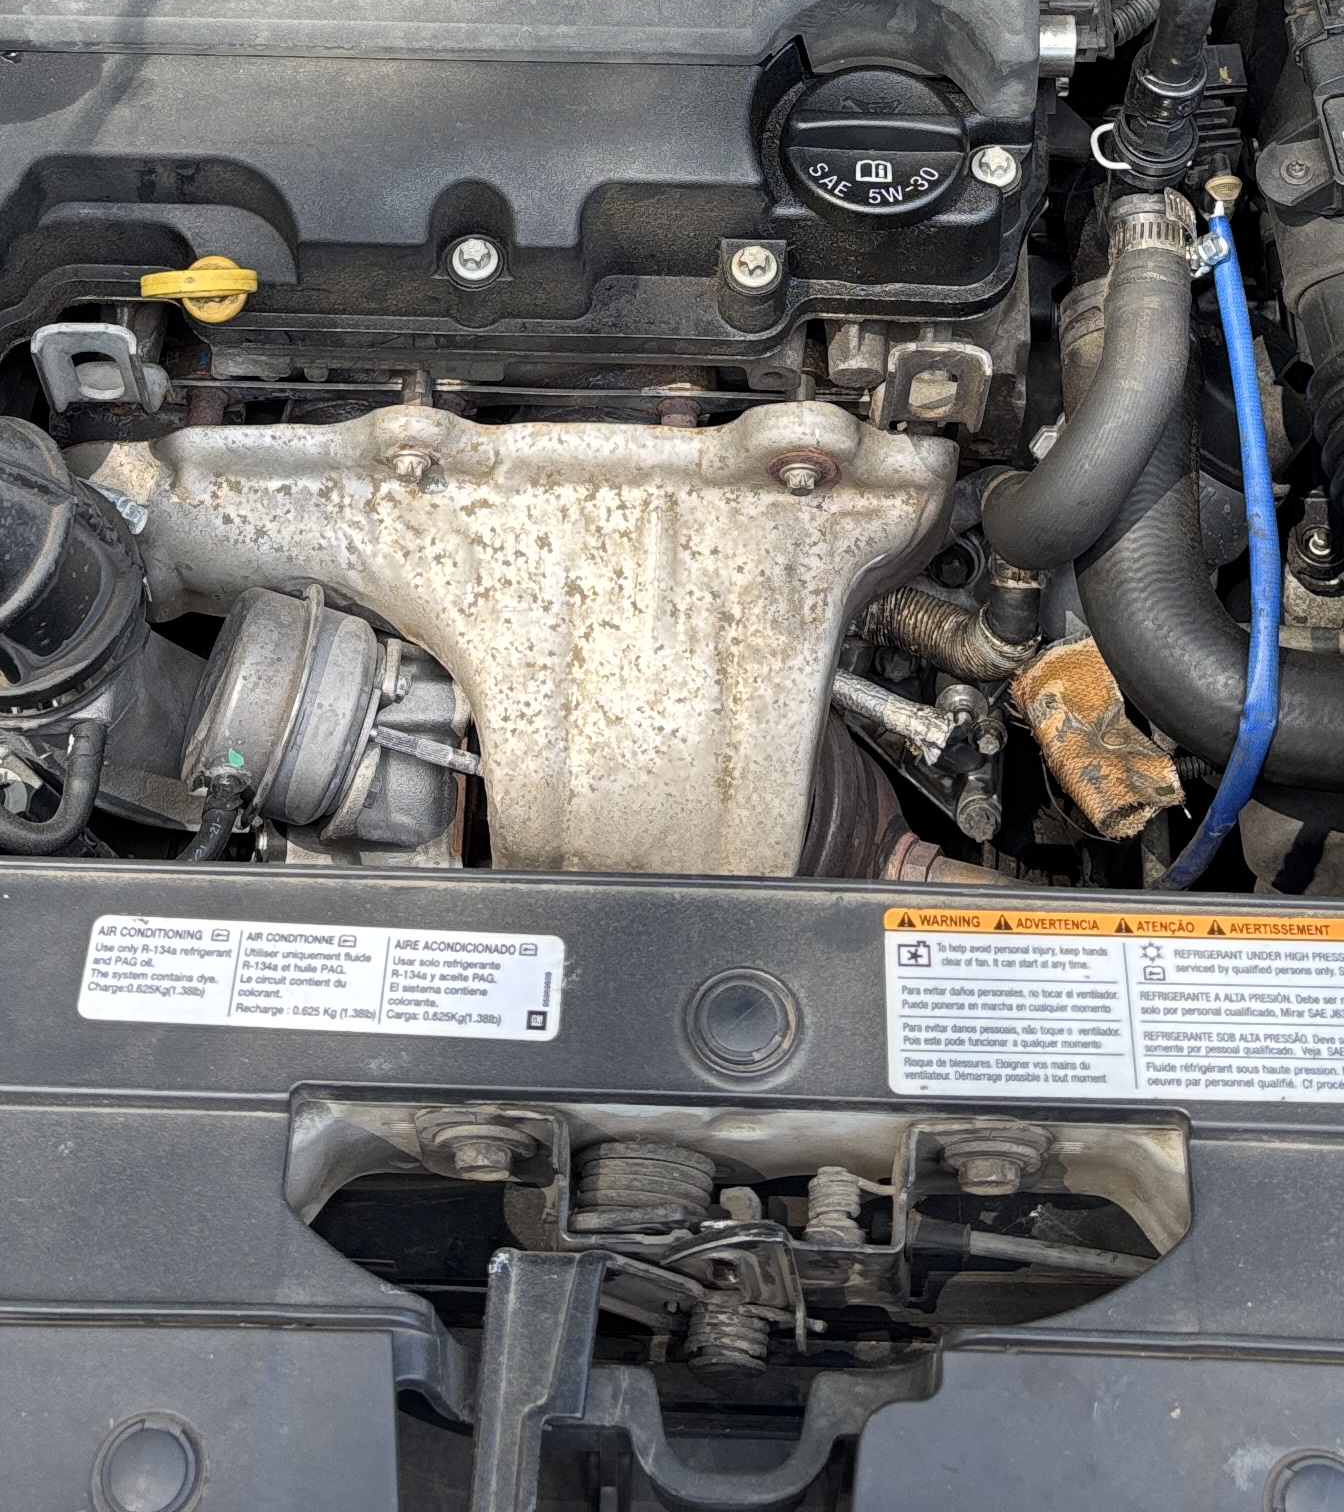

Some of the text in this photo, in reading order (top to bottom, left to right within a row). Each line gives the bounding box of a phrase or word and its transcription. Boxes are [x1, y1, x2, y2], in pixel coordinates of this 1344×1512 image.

[808, 162, 939, 204] SAE 5W-30
[919, 914, 1331, 936] WARNING ADVERTENCIA ATENÇÃO AVERTISSEMENT
[97, 925, 204, 940] AIR CONDITIONING
[246, 931, 264, 941] AIR
[94, 943, 232, 958] Use only R-134a refrigerant
[394, 939, 517, 954] AIRE ACONDICIONADO
[936, 942, 947, 952] To
[968, 944, 991, 953] avoid
[993, 946, 1029, 955] personal
[1059, 947, 1080, 956] keep
[1081, 947, 1107, 956] hands
[92, 956, 112, 965] and
[113, 956, 138, 966] PAG
[243, 948, 372, 962] Utiliser uniquement fluide
[391, 956, 416, 966] Usar
[418, 959, 441, 967] solo
[1173, 949, 1242, 960] REFRIGERANT
[1246, 950, 1282, 960] UNDER
[1284, 951, 1309, 961] HIGH
[241, 960, 279, 971] R-134a
[280, 963, 291, 972] et
[292, 963, 318, 973] huile
[1175, 964, 1215, 973] serviced
[1217, 964, 1229, 975] by
[1231, 964, 1272, 974] qualified
[1274, 967, 1312, 975] persons
[1314, 967, 1336, 977] only.
[91, 968, 219, 984] The system contains dye.
[239, 974, 347, 988] Le circuit contient du
[390, 969, 428, 980] R-134a
[428, 973, 436, 982] y
[438, 972, 470, 982] aceite
[388, 981, 488, 996] El sistema contiene
[1139, 990, 1211, 1002] REFRIGERANTE
[1213, 992, 1221, 1002] A
[1223, 992, 1246, 1003] ALTA
[1295, 994, 1320, 1004] Debe
[1322, 996, 1337, 1004] ser
[235, 1003, 284, 1016] Recharge
[291, 1005, 321, 1016] 0.625
[321, 1007, 338, 1019] Kg
[1146, 1062, 1177, 1072] Fluide
[1235, 1065, 1260, 1074] sous
[1262, 1065, 1291, 1074] haute
